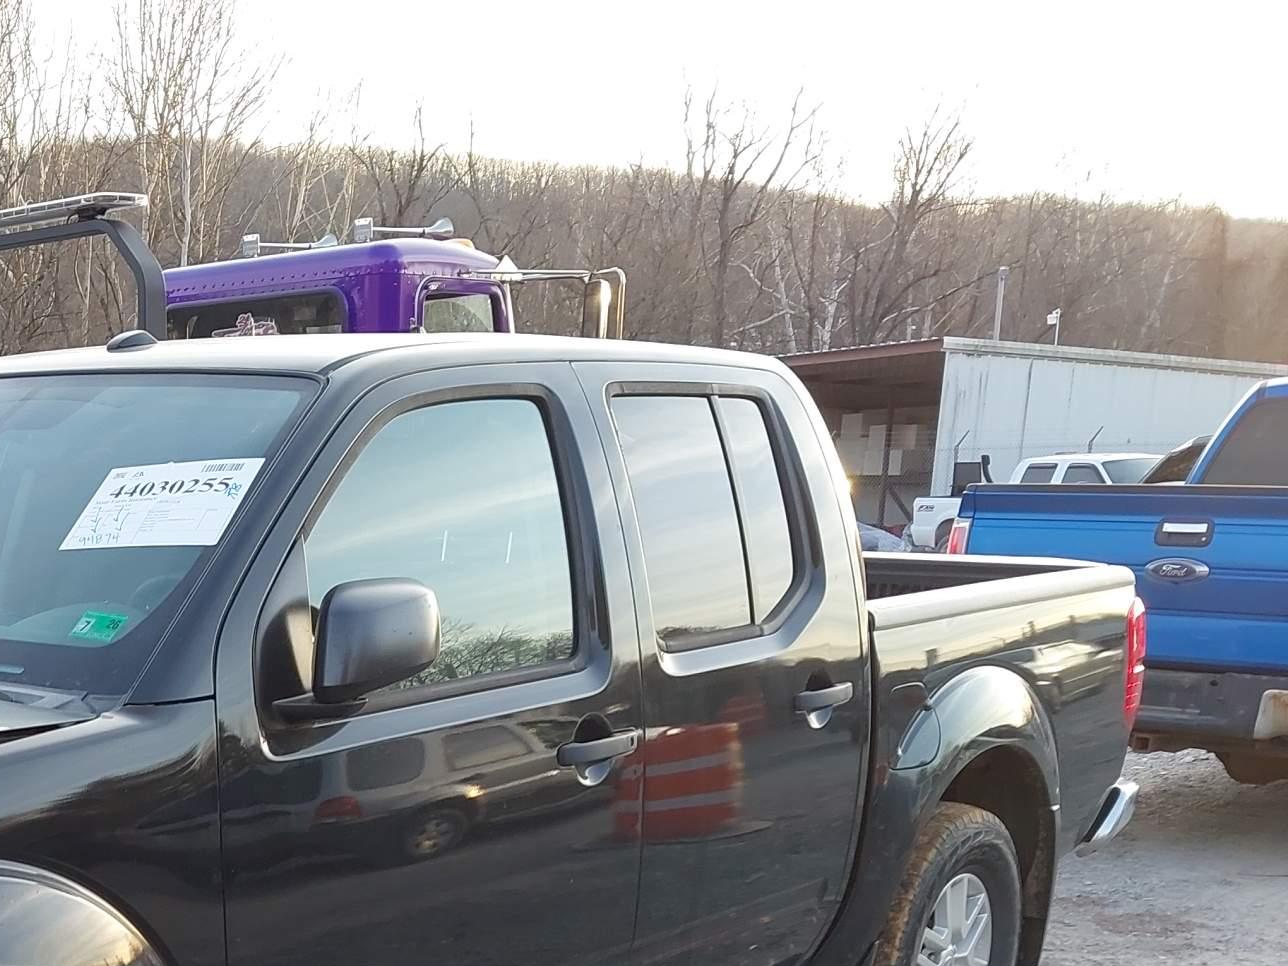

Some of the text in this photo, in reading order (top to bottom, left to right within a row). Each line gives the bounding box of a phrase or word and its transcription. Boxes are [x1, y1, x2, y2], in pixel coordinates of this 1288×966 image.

[109, 477, 233, 499] 44030255
[1159, 563, 1188, 577] Ford
[80, 620, 91, 632] 7
